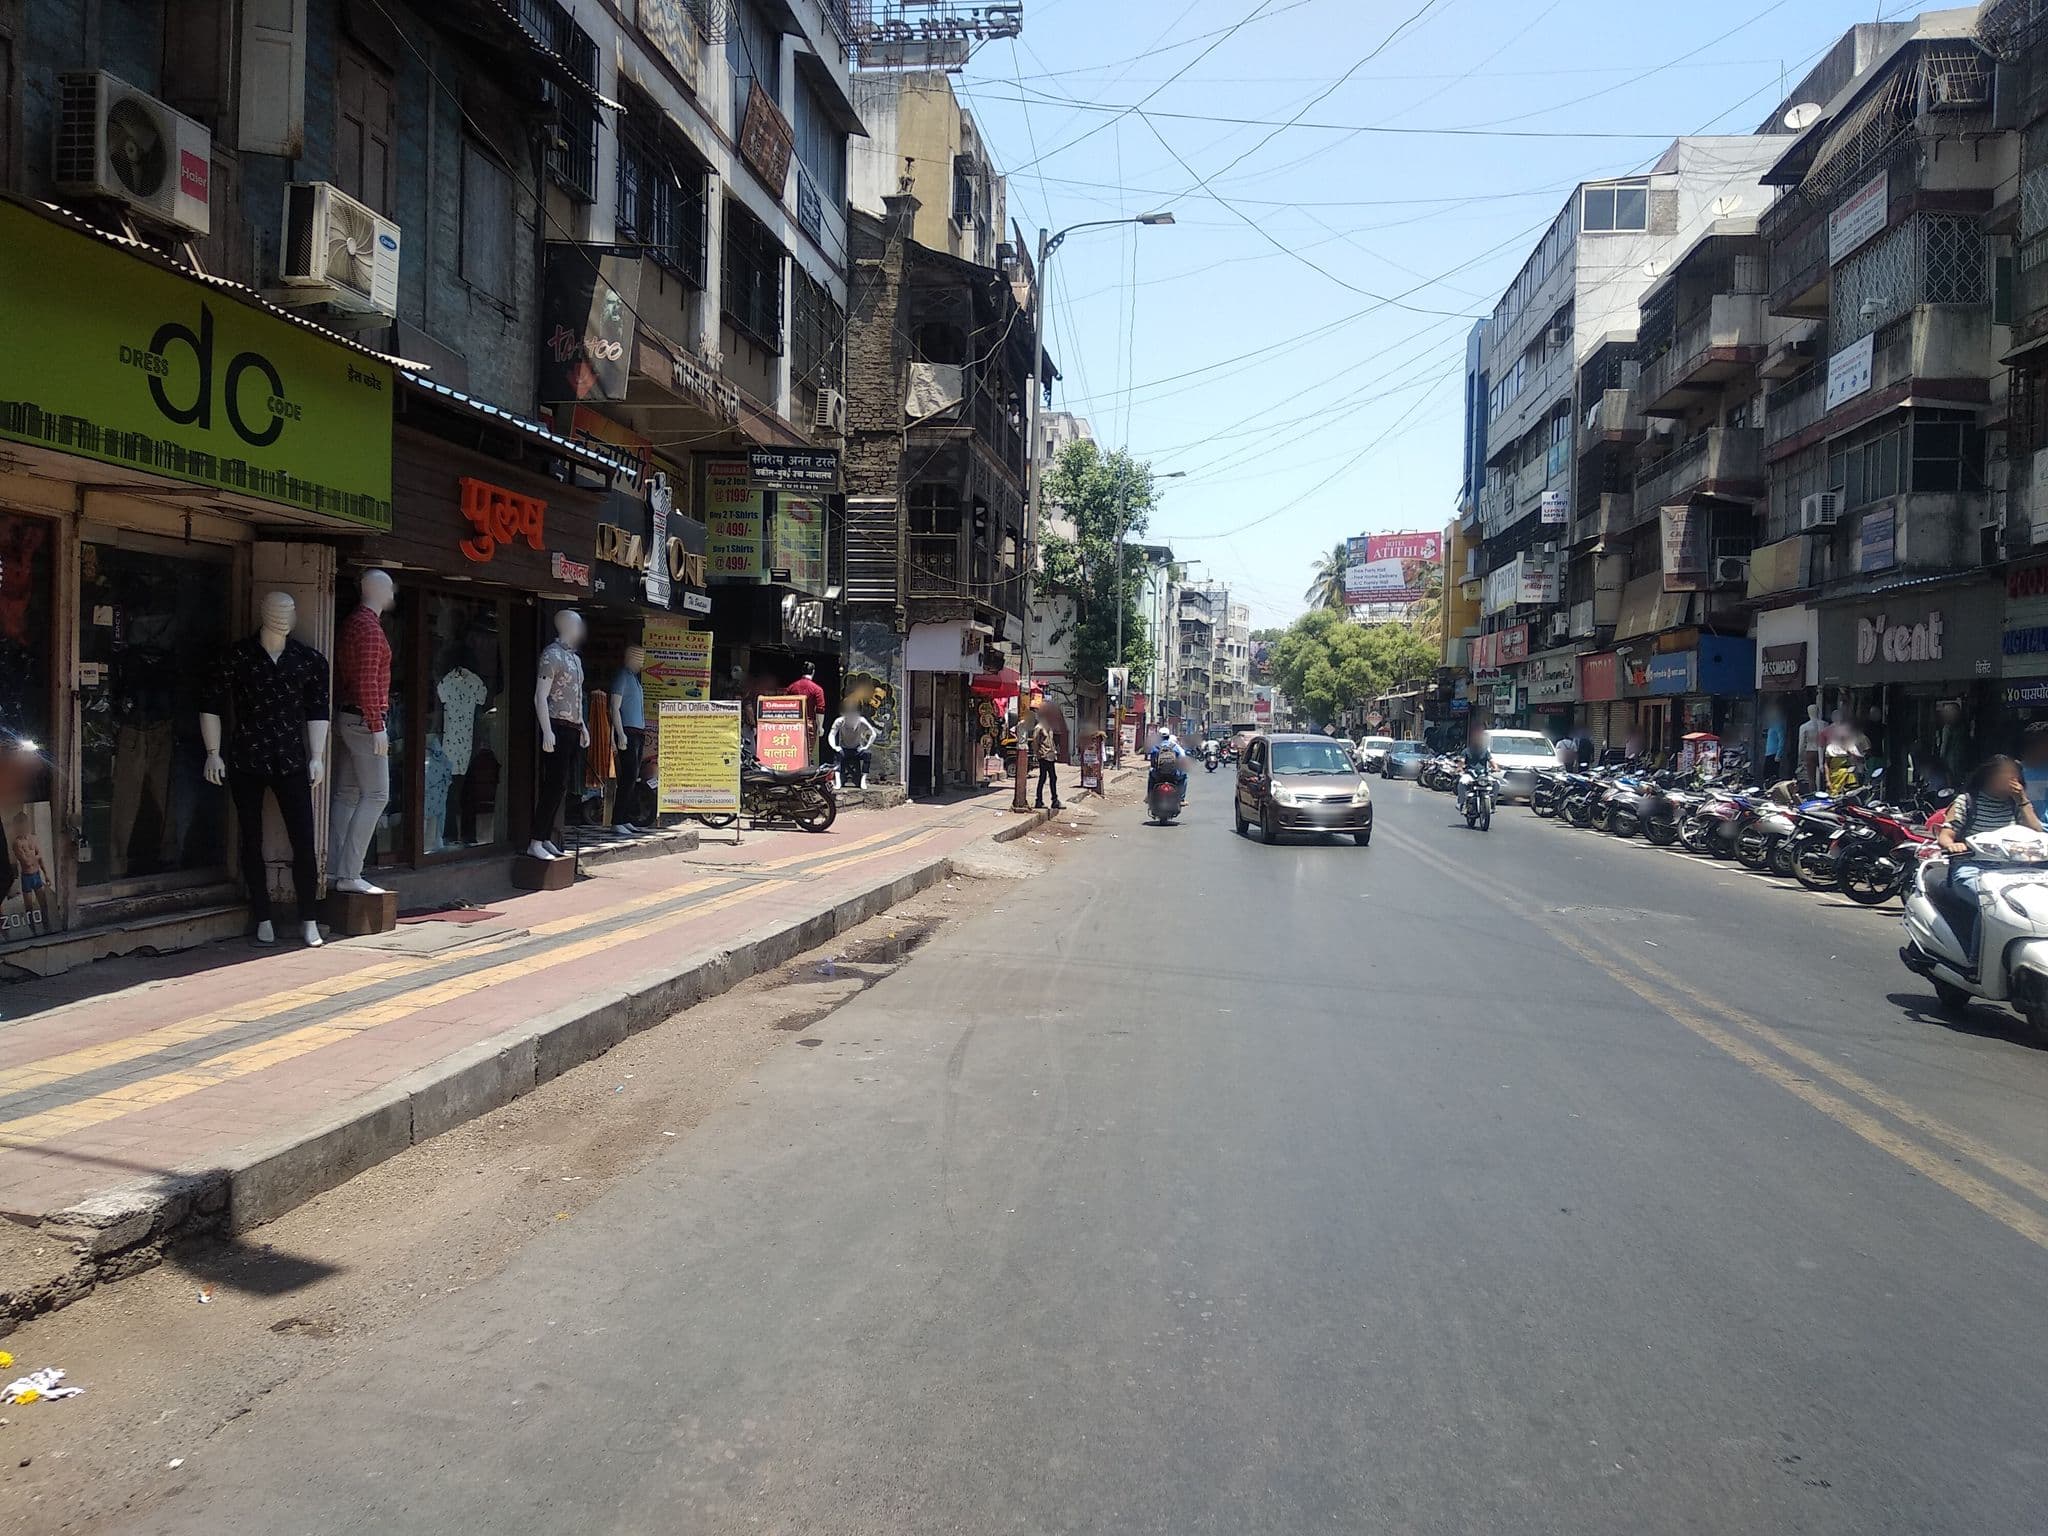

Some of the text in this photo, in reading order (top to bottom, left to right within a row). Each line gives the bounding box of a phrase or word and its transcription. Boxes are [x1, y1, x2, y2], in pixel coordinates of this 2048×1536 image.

[182, 165, 208, 188] Haier
[119, 344, 170, 377] DRESS
[267, 394, 302, 421] CODE
[788, 451, 812, 467] अनंत
[816, 453, 838, 468] टरले
[726, 487, 754, 502] 1199/-
[729, 510, 759, 520] T-Shirts
[726, 522, 752, 537] 499/-
[731, 544, 754, 554] Shirts
[1374, 546, 1417, 559] ATITHI
[667, 536, 708, 589] ONE
[725, 556, 752, 570] 499/-
[648, 632, 681, 641] Print
[686, 634, 705, 642] On
[1857, 610, 1944, 665] D'cent
[643, 640, 710, 650] Cyber cafe
[2007, 687, 2020, 702] ४०
[661, 702, 676, 712] Print
[677, 702, 688, 712] On
[689, 702, 710, 712] Online
[772, 732, 790, 746] श्री
[763, 744, 797, 759] बालाजी
